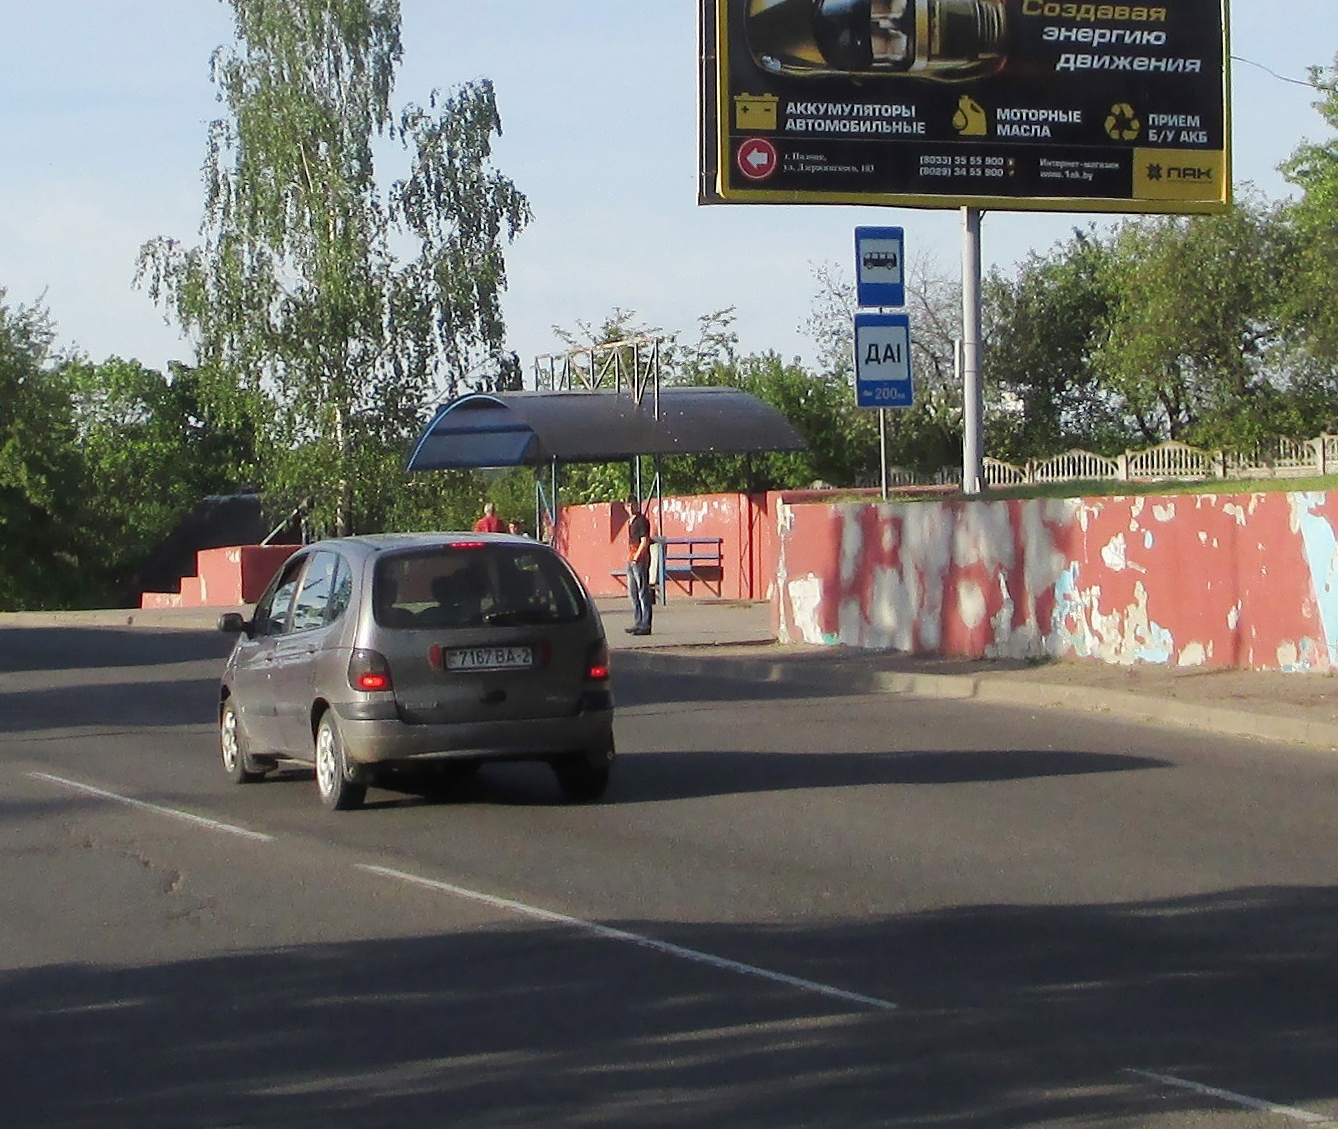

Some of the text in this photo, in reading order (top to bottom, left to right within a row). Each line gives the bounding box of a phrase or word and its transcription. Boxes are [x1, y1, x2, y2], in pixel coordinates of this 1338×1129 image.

[1042, 26, 1167, 47] энергию
[1056, 53, 1202, 73] движения
[785, 102, 916, 118] АККУМУЛЯТОРЫ
[996, 108, 1082, 123] МОТОРНЫЕ
[784, 118, 926, 134] АВТОМОБИЛЬНЫЕ
[1148, 114, 1200, 128] ПРИЕМ
[996, 124, 1052, 138] МАСЛА
[1148, 129, 1208, 144] Б/У АКБ
